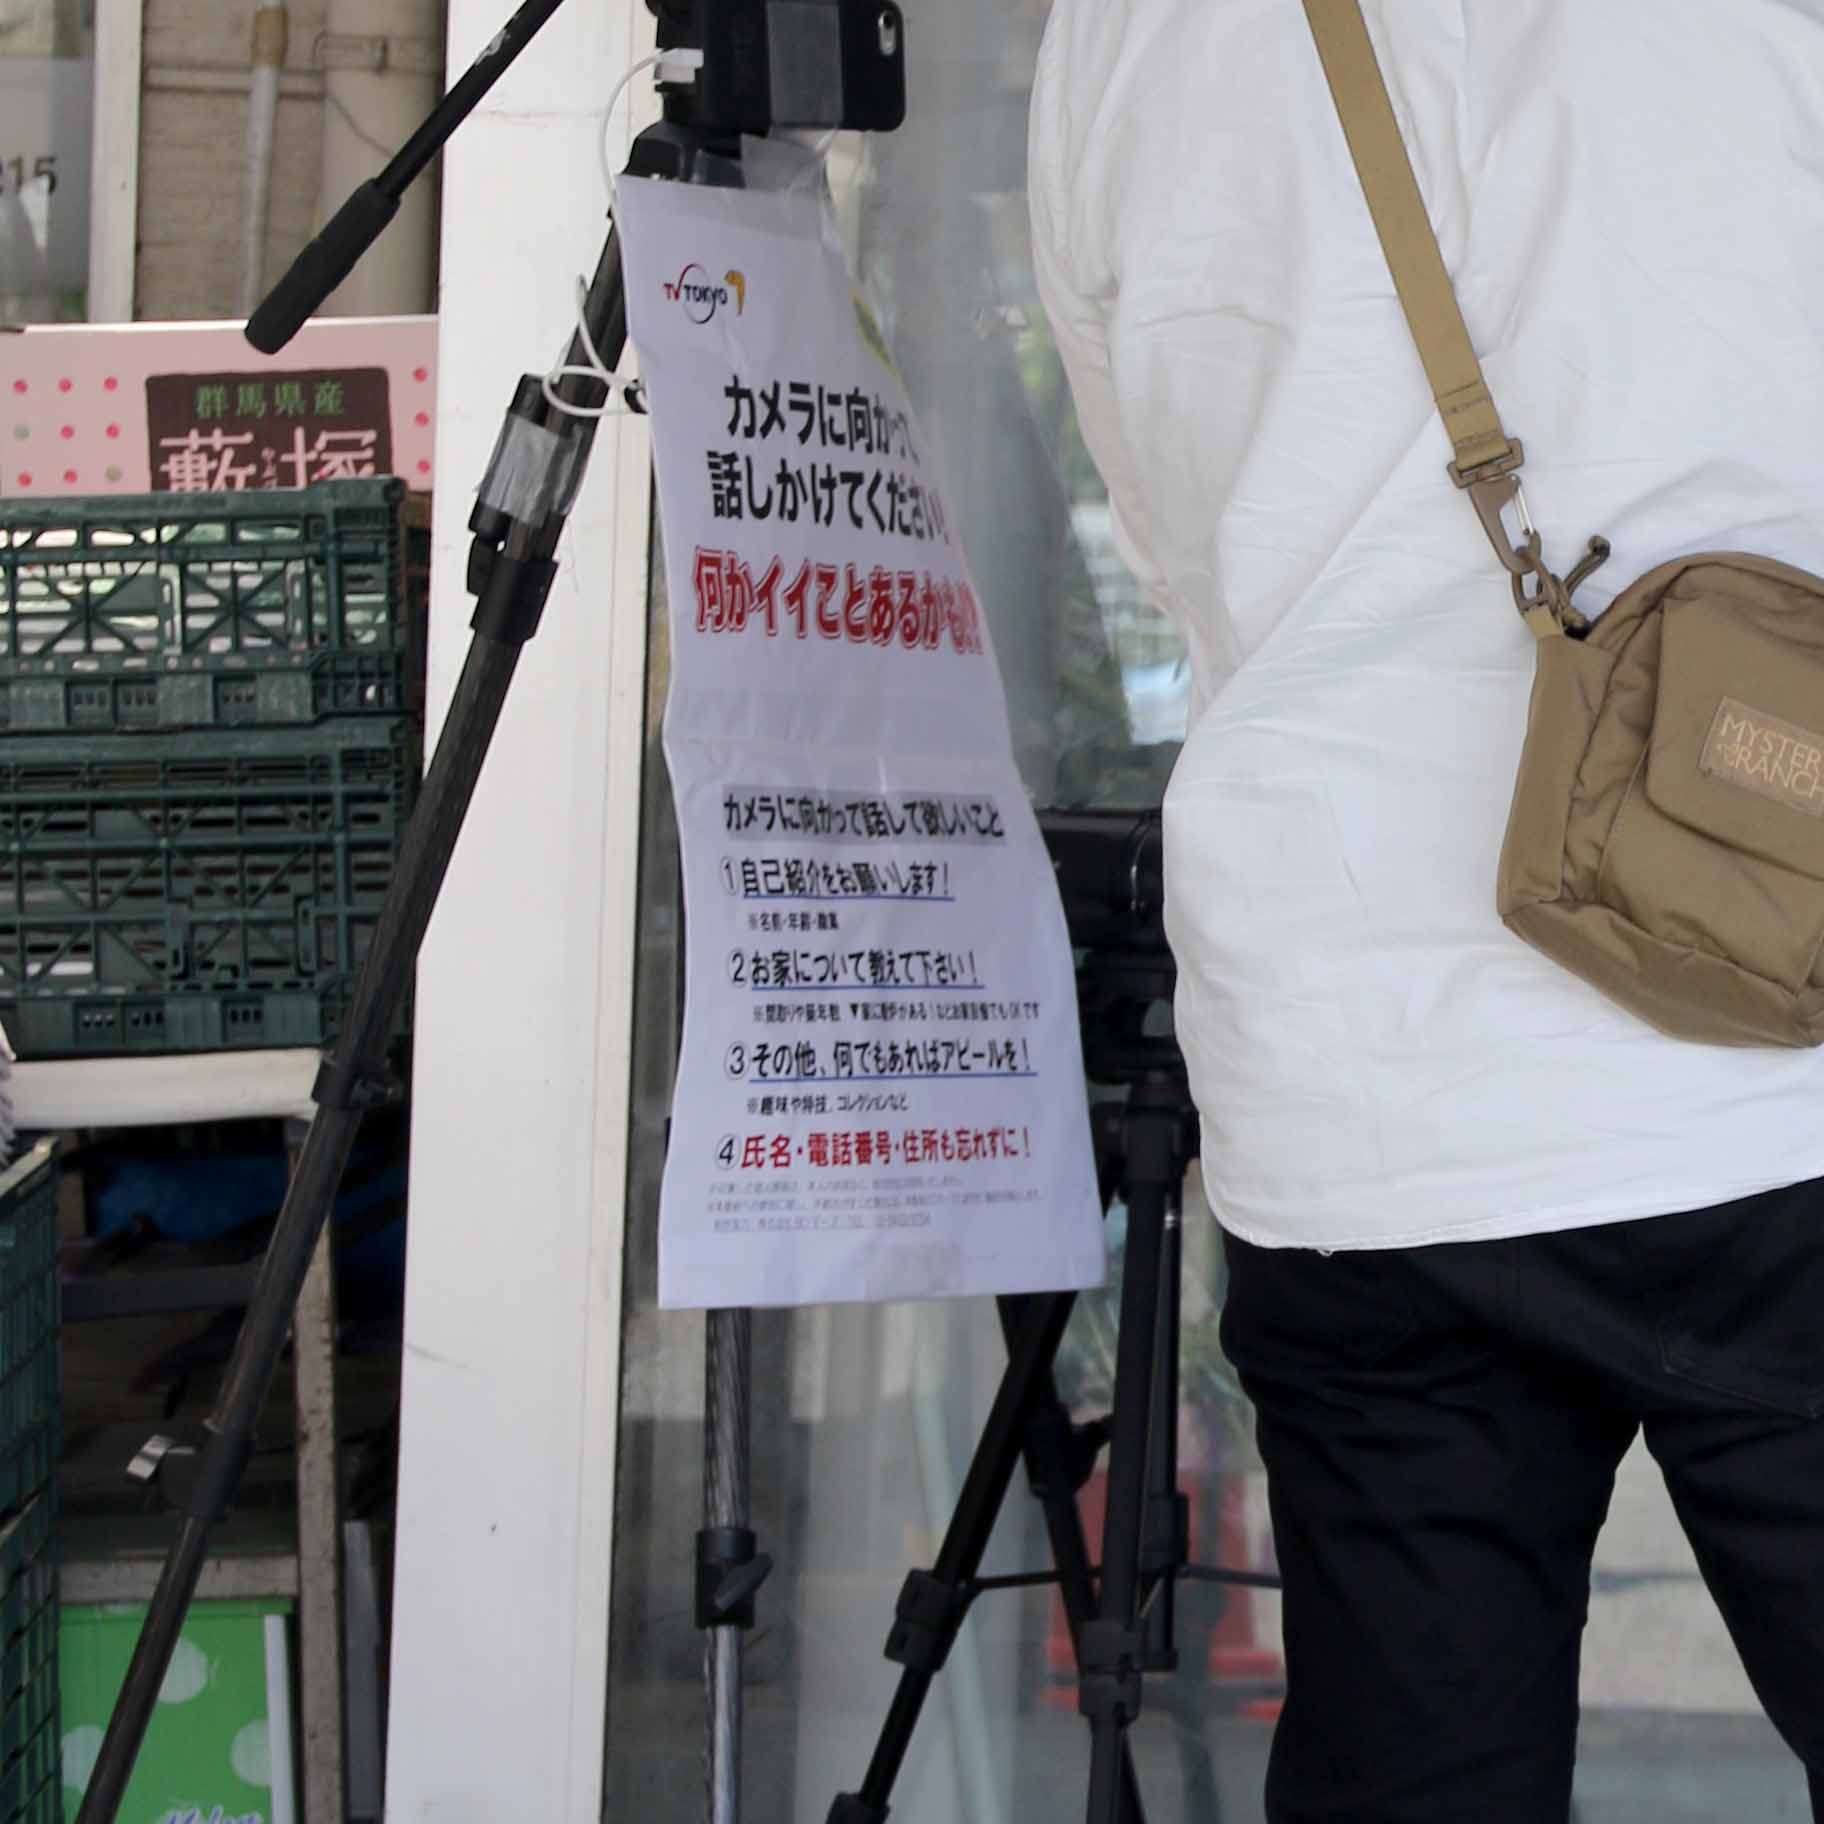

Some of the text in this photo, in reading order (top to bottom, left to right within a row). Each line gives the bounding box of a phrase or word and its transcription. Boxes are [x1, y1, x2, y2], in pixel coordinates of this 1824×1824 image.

[0, 155, 57, 196] 15
[663, 282, 682, 301] TV
[196, 380, 345, 420] 群馬県産
